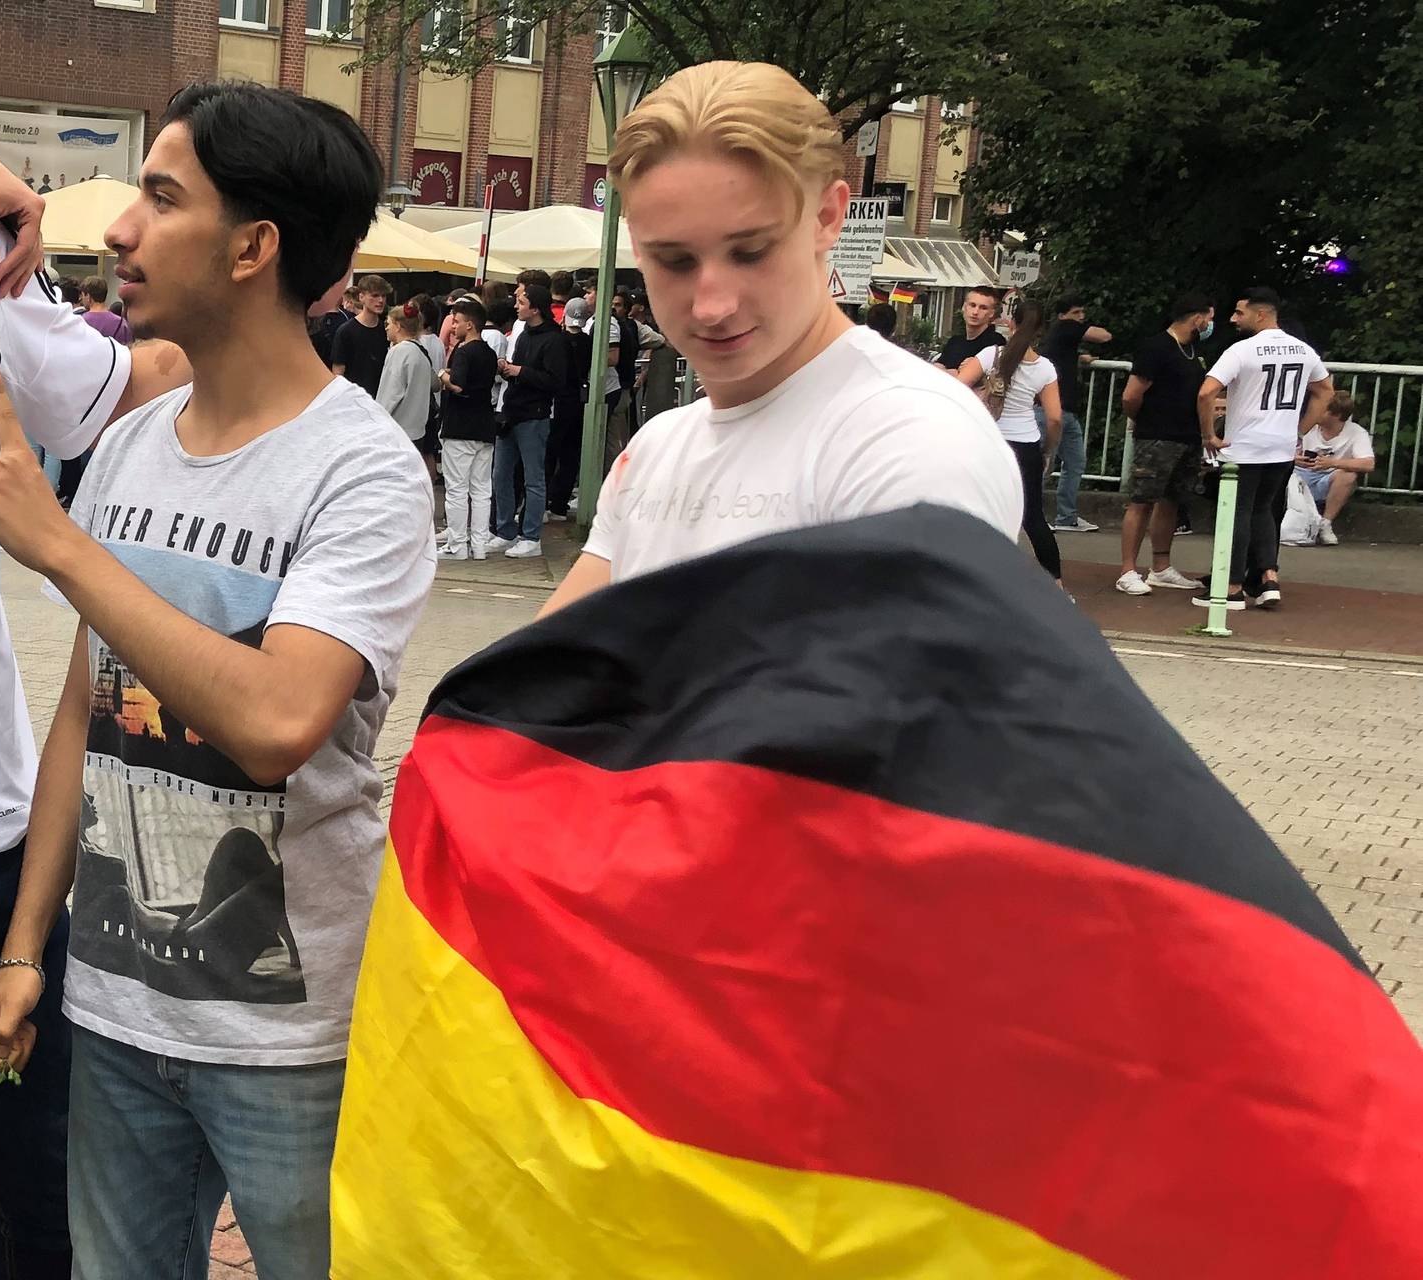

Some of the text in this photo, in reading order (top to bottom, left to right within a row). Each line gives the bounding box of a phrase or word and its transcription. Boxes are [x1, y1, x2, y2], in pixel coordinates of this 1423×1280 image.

[27, 126, 40, 136] 2.0
[509, 170, 523, 198] Pub
[844, 201, 885, 220] RKEN
[1260, 363, 1304, 411] 10
[153, 772, 195, 795] EDGE
[211, 789, 285, 809] MUSIC
